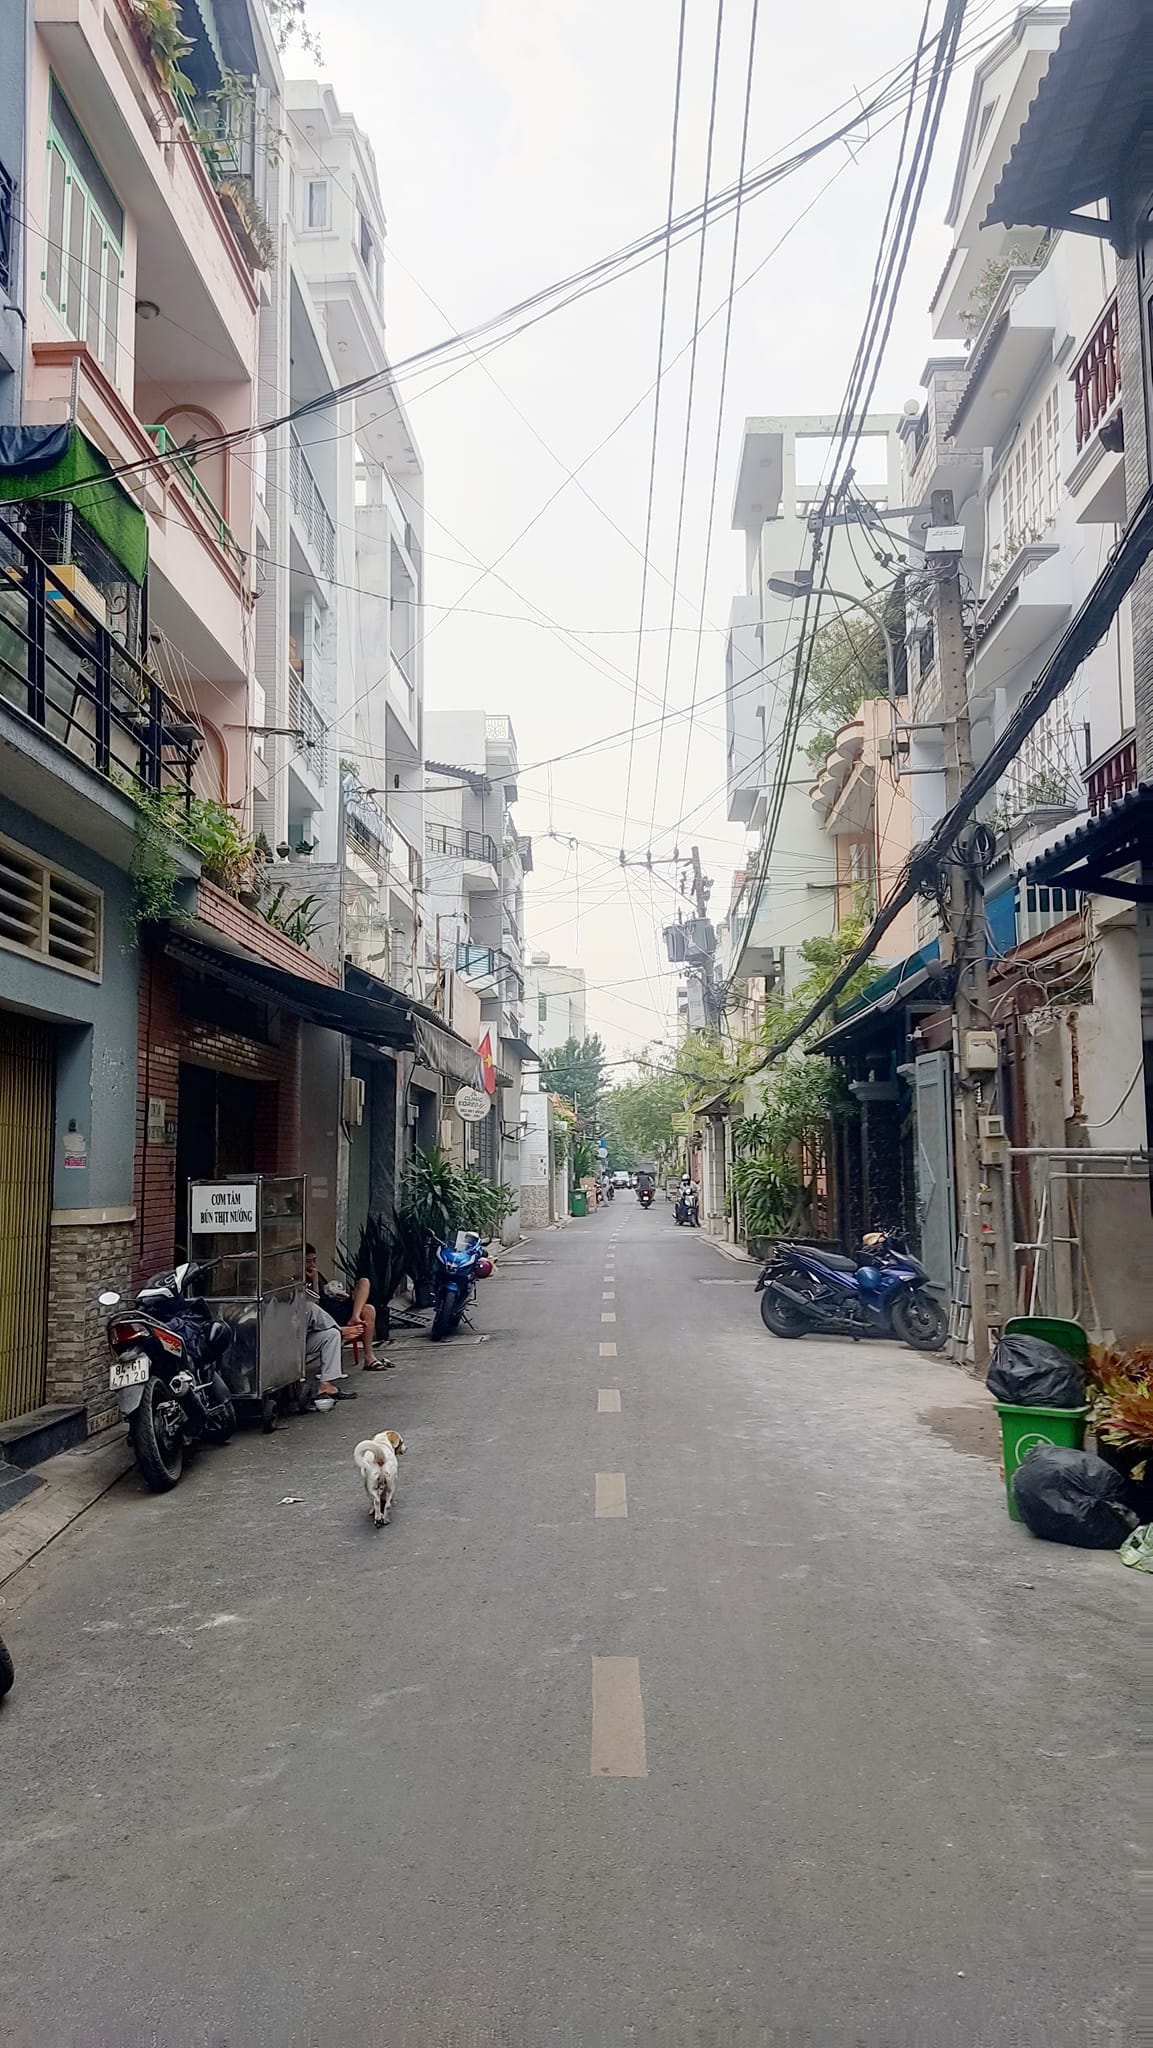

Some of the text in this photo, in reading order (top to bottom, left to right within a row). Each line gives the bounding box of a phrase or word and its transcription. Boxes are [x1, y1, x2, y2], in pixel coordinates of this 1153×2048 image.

[200, 1208, 253, 1226] BÚN THỊT NƯỚNG
[115, 1360, 142, 1376] 84-G1
